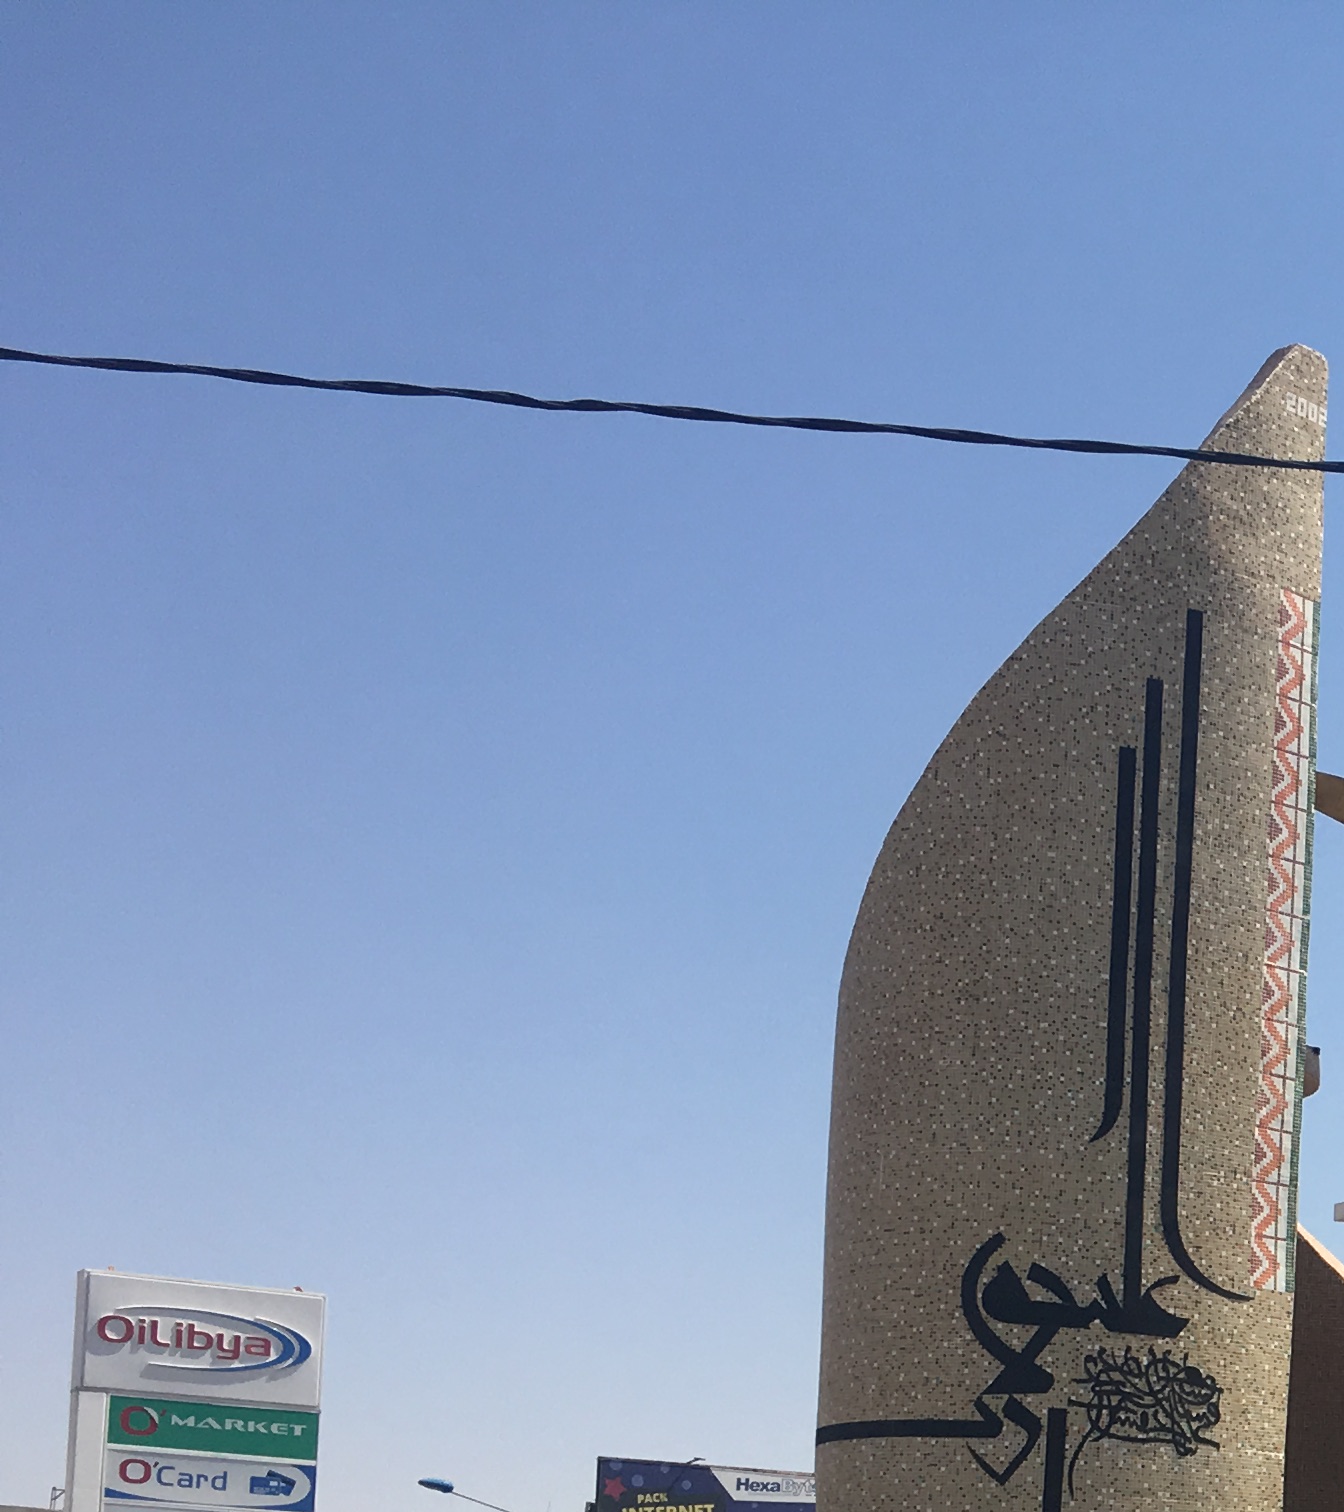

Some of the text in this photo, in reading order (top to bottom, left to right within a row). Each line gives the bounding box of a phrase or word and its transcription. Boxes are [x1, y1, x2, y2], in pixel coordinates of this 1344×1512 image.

[97, 1315, 271, 1360] OiLibya
[118, 1458, 227, 1491] O'Card
[637, 1492, 668, 1504] PACK
